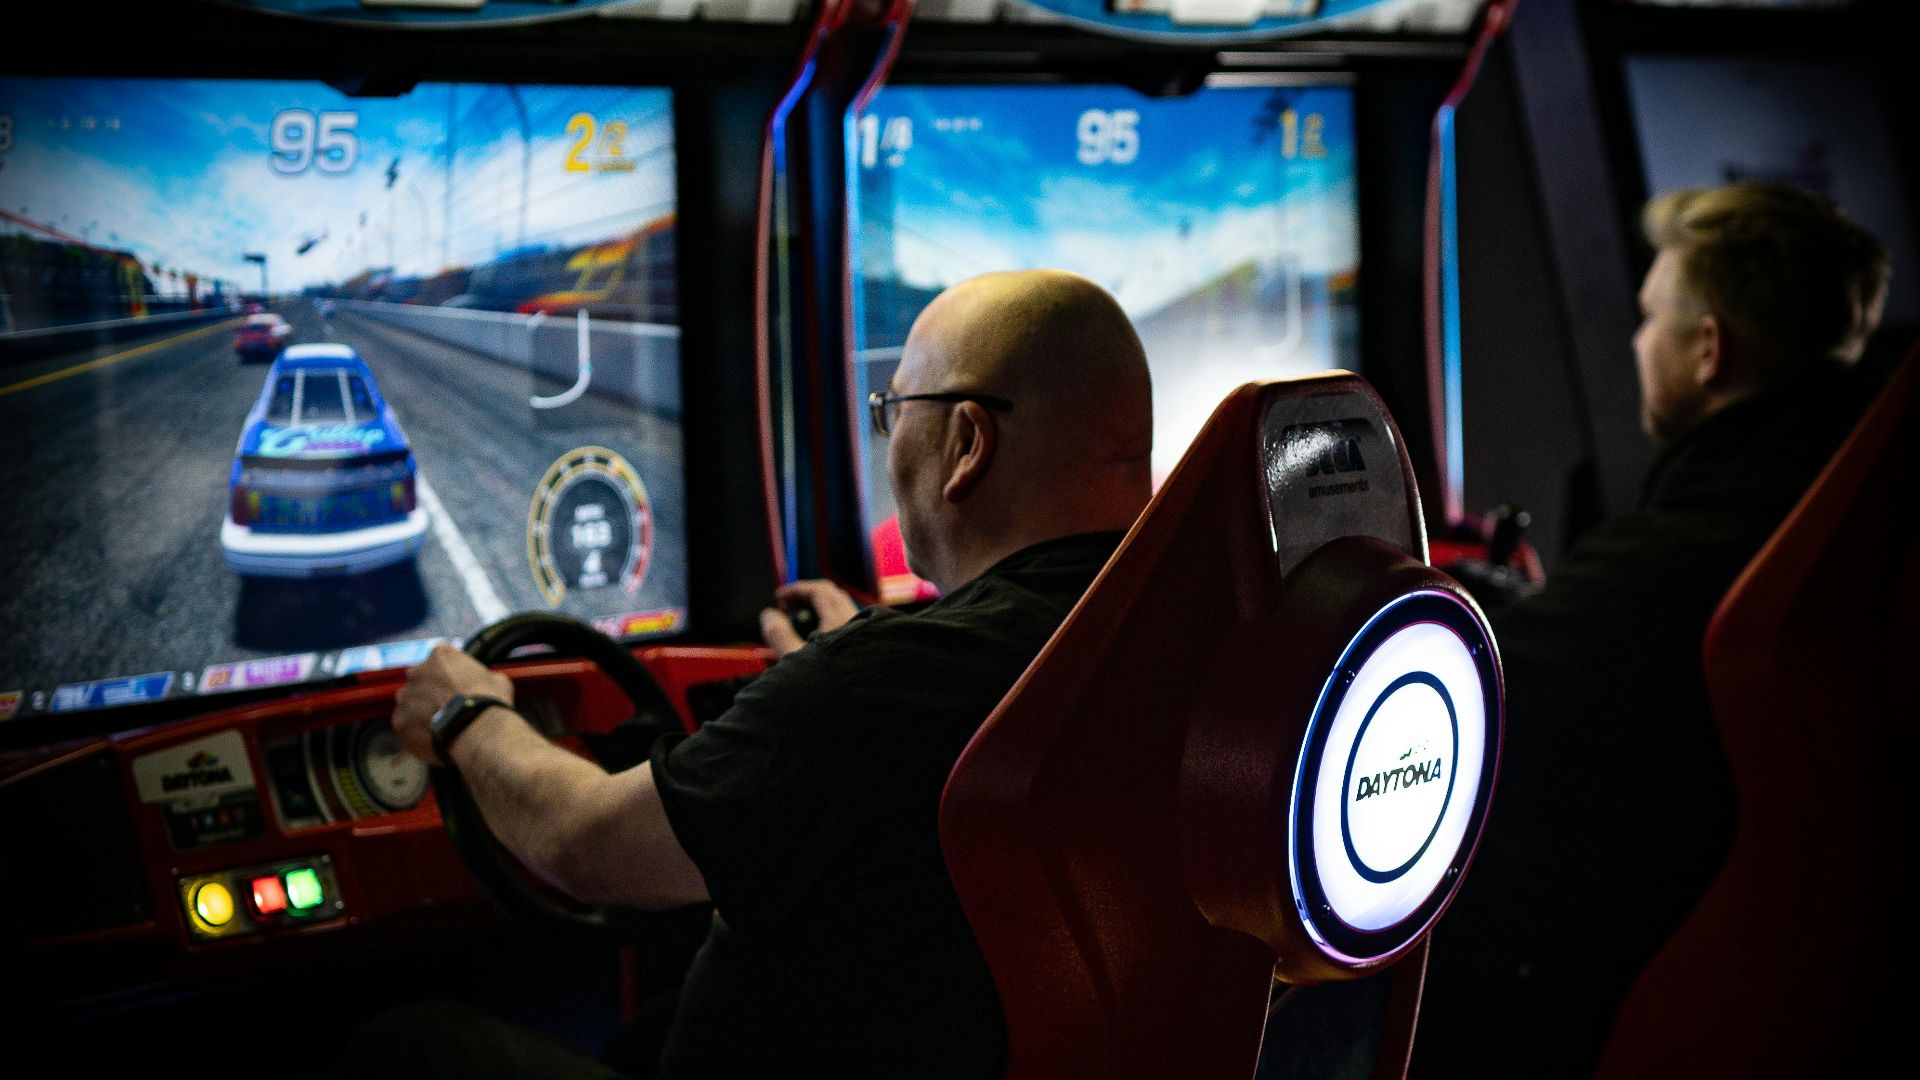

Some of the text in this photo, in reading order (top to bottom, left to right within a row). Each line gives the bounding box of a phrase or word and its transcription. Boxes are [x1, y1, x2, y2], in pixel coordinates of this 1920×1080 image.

[271, 109, 358, 174] 95
[1076, 108, 1140, 165] 95
[1308, 478, 1370, 499] amusements
[1355, 757, 1442, 802] DAYTONA
